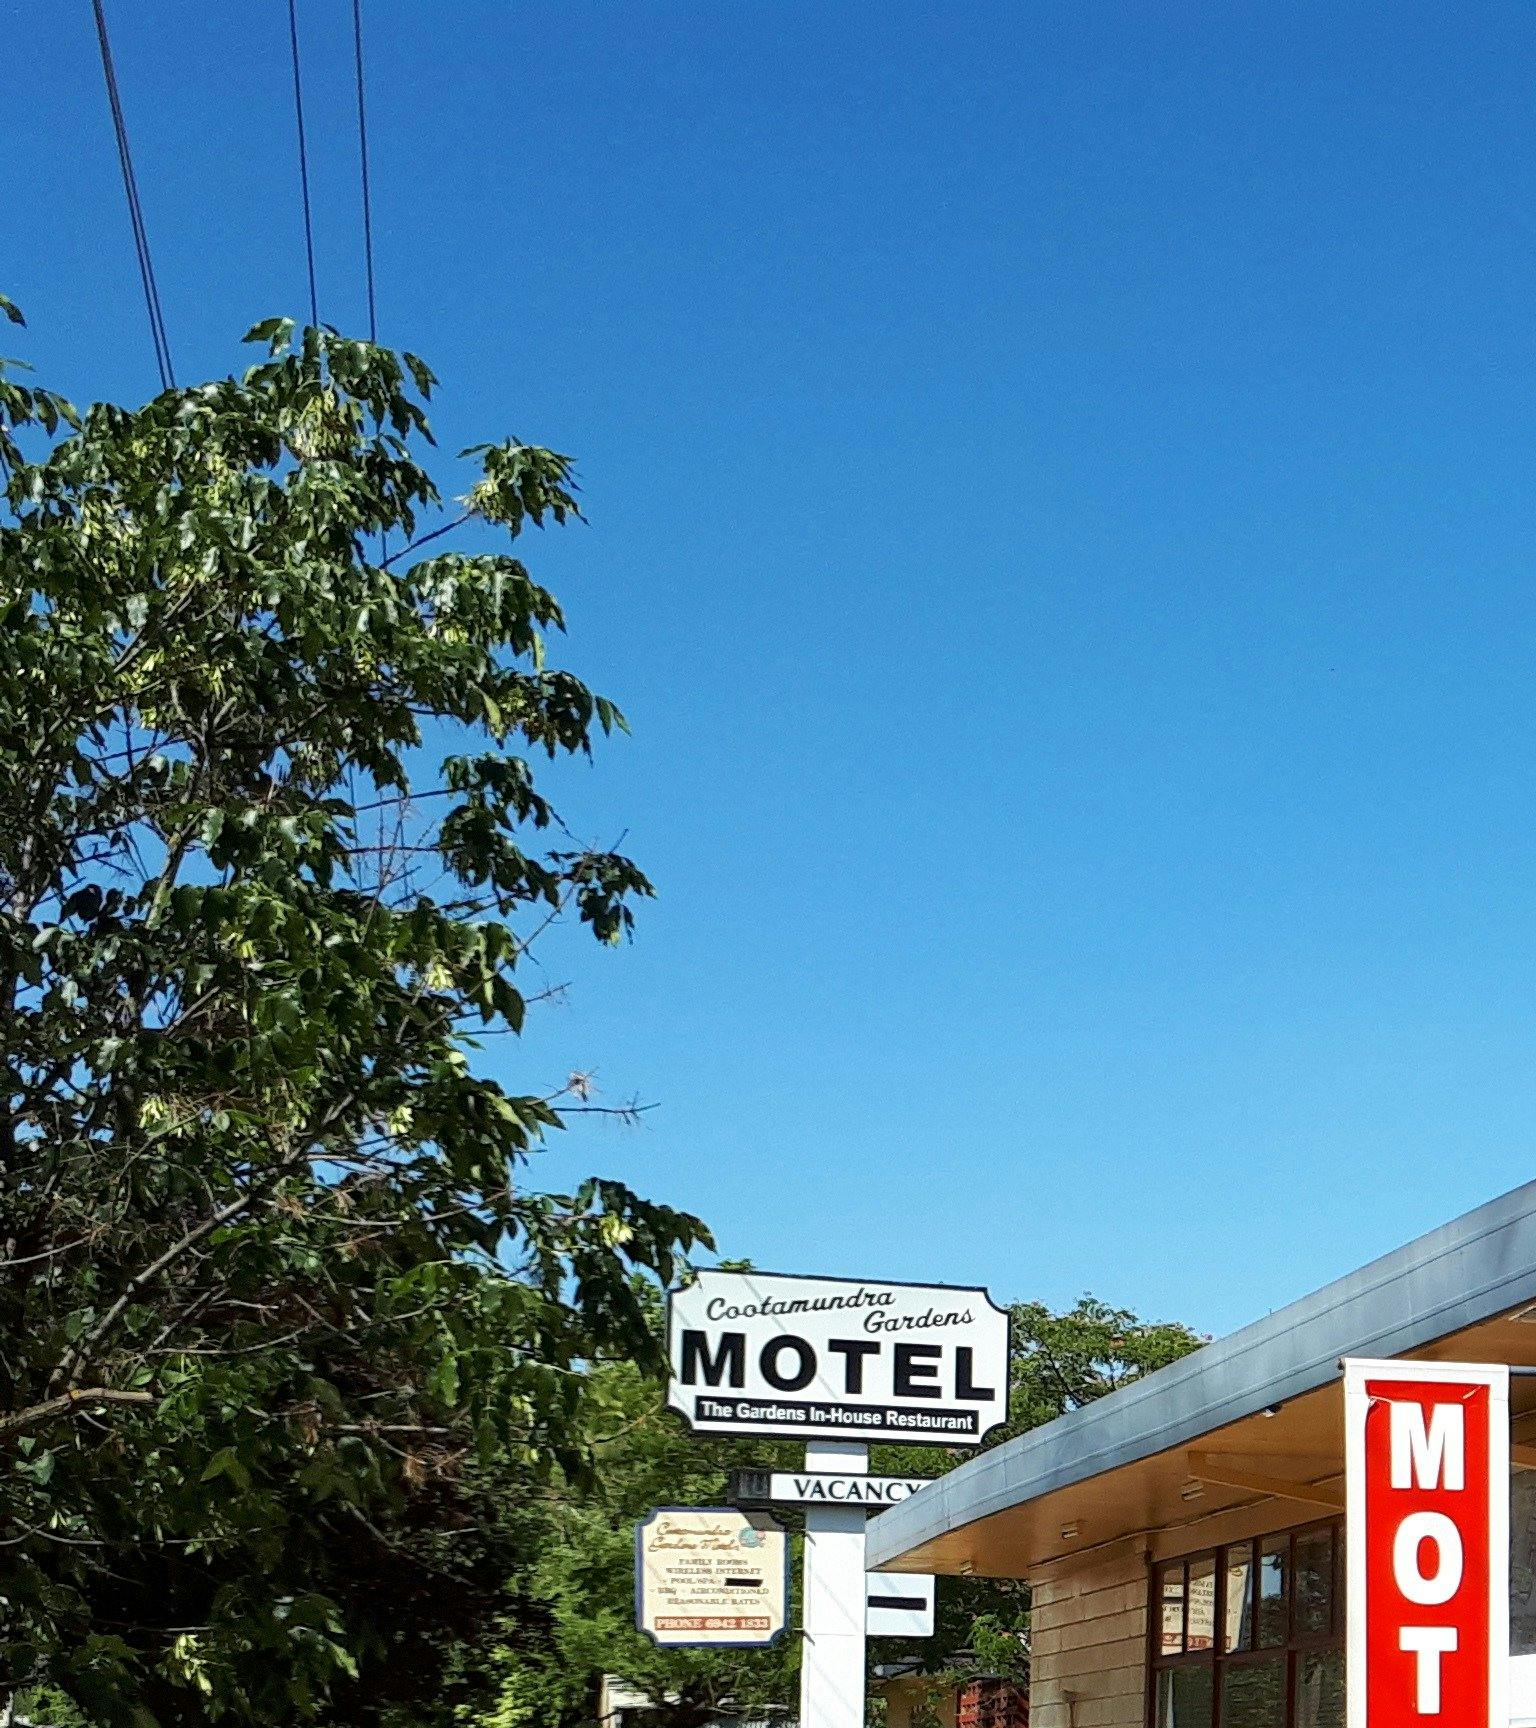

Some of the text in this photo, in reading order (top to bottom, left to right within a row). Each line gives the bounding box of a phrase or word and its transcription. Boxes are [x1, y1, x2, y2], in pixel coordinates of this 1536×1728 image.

[706, 1287, 896, 1321] Cootamundra
[862, 1308, 975, 1333] Gardens
[681, 1329, 996, 1402] MOTEL
[702, 1400, 974, 1431] The Gardens In-House Restaurant
